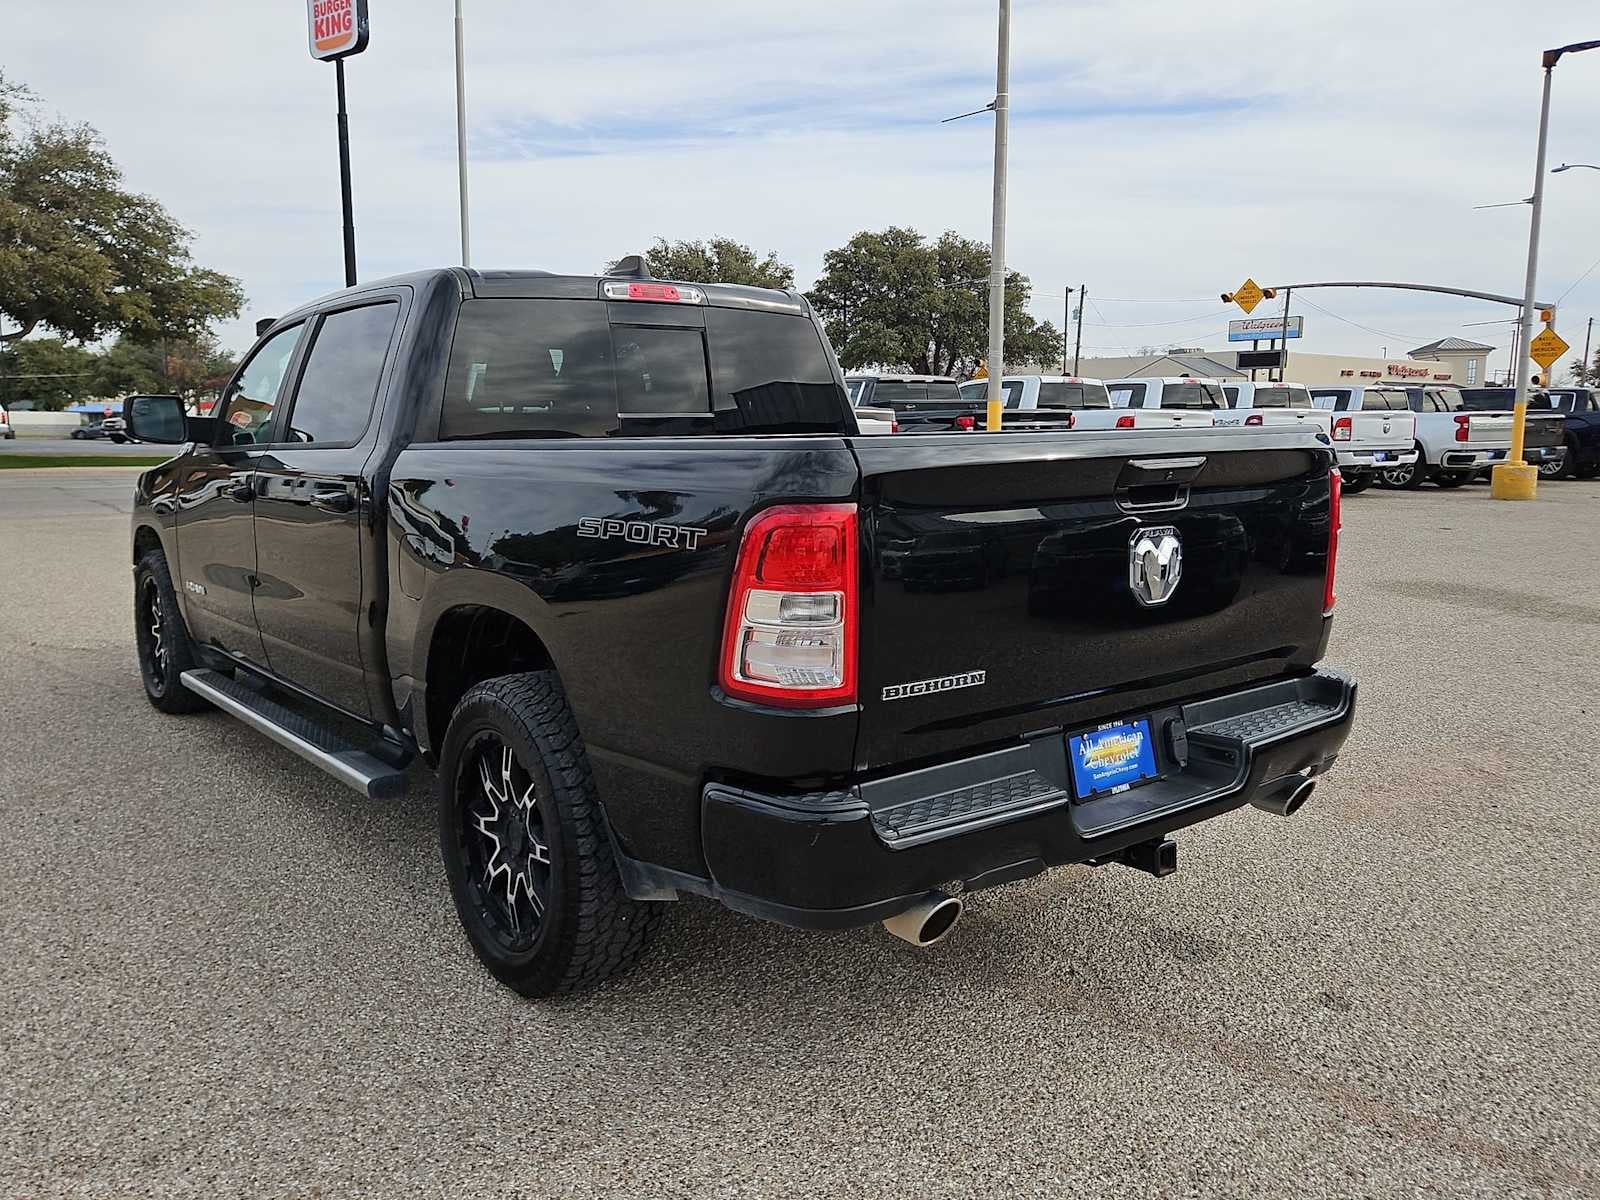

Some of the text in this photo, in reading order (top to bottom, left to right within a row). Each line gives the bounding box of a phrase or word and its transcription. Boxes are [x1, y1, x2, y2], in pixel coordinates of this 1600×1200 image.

[314, 0, 351, 18] BURGER
[314, 10, 352, 40] KING
[577, 516, 708, 550] SPORT
[882, 670, 986, 701] BIGHORN
[1079, 731, 1144, 755] All American
[1090, 747, 1139, 769] Chevrolet
